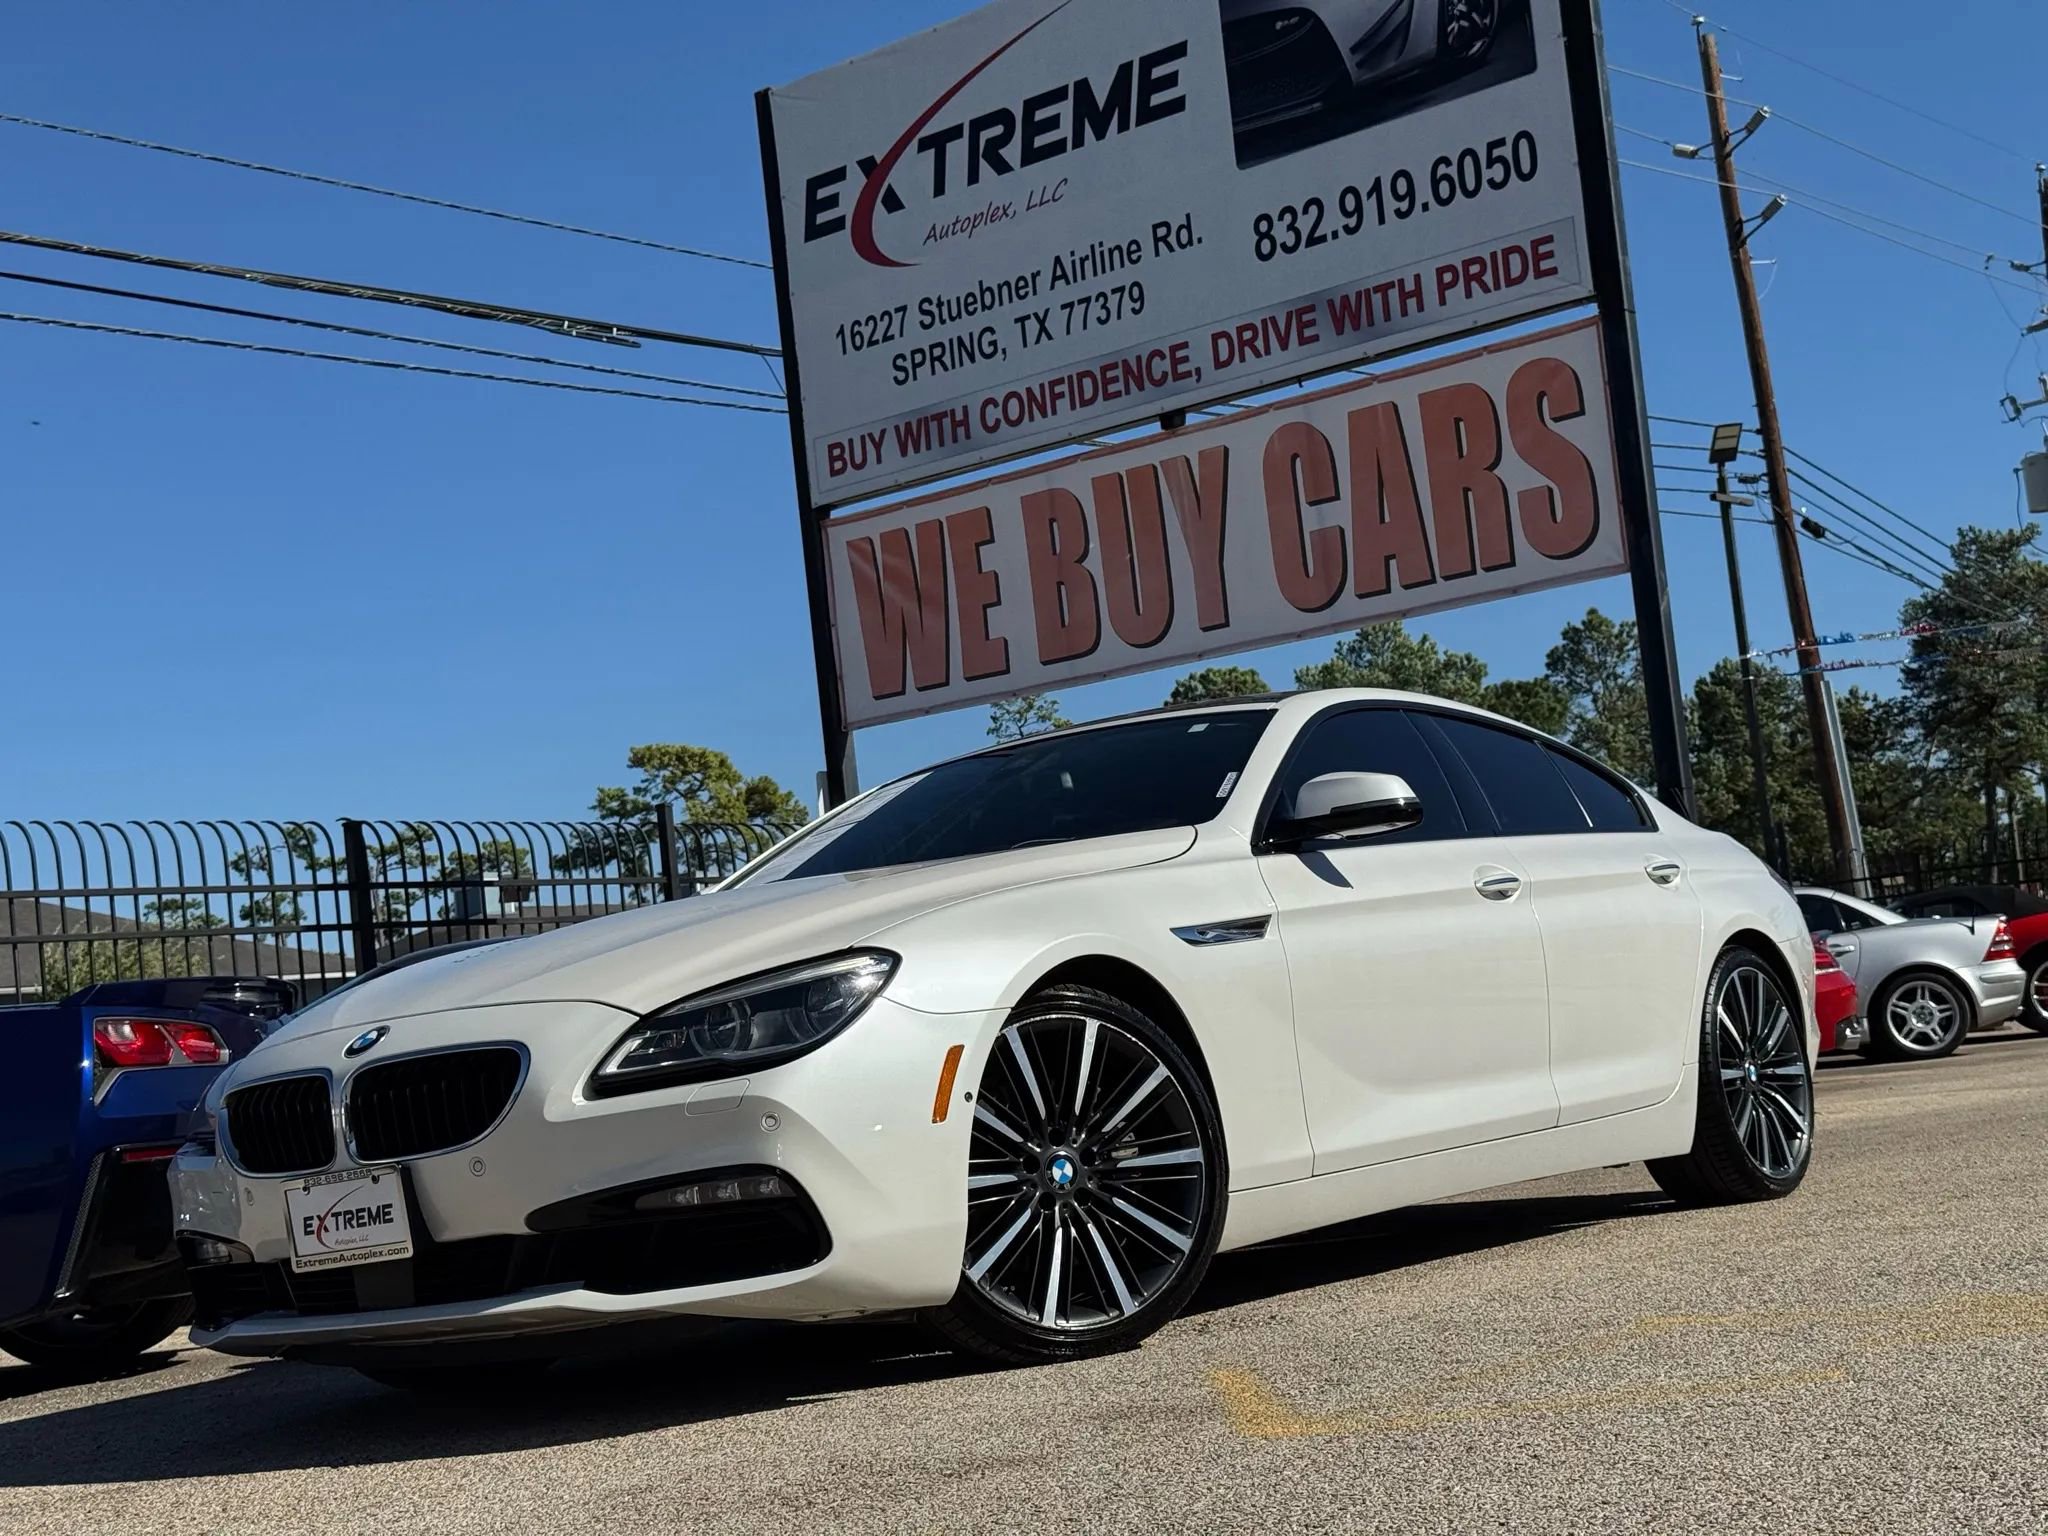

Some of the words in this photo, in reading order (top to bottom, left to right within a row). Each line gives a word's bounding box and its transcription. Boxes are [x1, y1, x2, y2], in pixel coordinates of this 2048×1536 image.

[804, 40, 1188, 243] EXTREME
[1253, 129, 1538, 262] 832.919.6050
[922, 200, 1017, 246] Autoplex,
[1025, 177, 1069, 212] LLC
[835, 305, 908, 355] 16227
[918, 269, 1041, 331] Stuebner
[1049, 238, 1143, 291] Airline
[1152, 213, 1203, 258] Rd.
[892, 325, 1008, 386] SPRING,
[1014, 307, 1054, 349] TX
[1060, 280, 1146, 336] 77379
[827, 428, 887, 478] BUY
[894, 404, 972, 458] WITH
[979, 341, 1202, 434] CONFIDENCE,
[1210, 303, 1320, 371] DRIVE
[1327, 273, 1425, 336] WITH
[1435, 234, 1559, 307] PRIDE
[846, 505, 1010, 700] WE
[1020, 445, 1230, 666] BUY
[1262, 357, 1600, 613] CARS
[296, 1245, 410, 1269] ExtremeAutoplex.com
[303, 1203, 394, 1236] EXTREME
